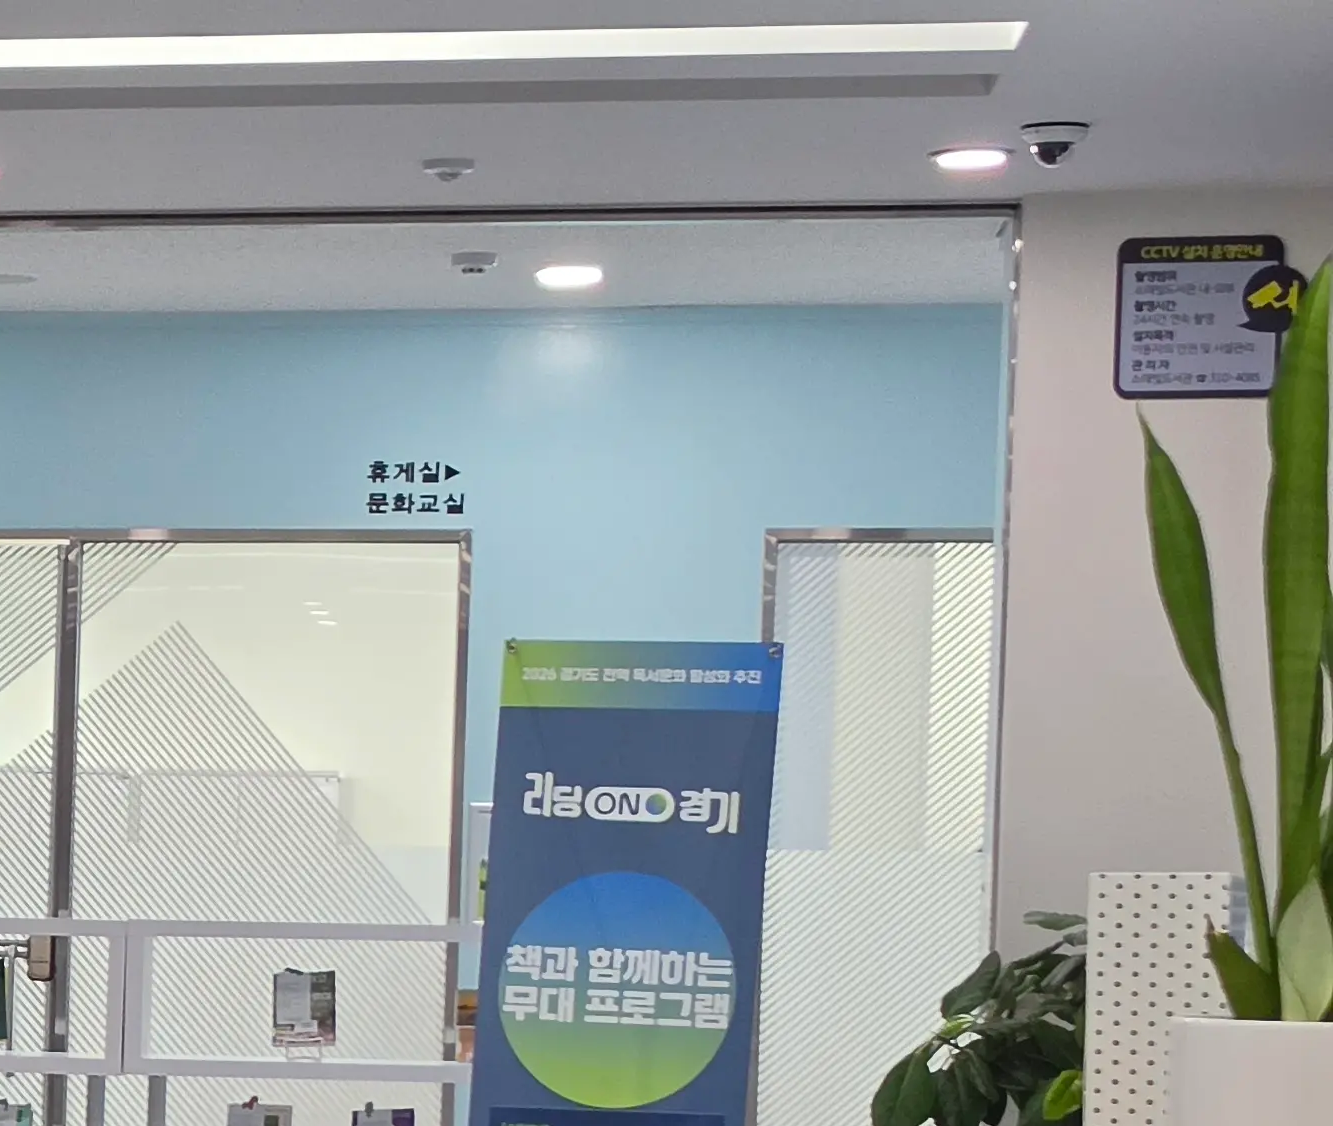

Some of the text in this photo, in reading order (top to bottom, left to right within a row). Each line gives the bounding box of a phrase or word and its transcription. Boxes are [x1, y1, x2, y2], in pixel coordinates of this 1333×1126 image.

[1140, 245, 1180, 259] CCTV
[366, 460, 441, 483] 휴게실
[366, 492, 465, 515] 문화교실
[505, 944, 734, 988] 책과 함께하는
[502, 986, 731, 1030] 무대 프로그램
